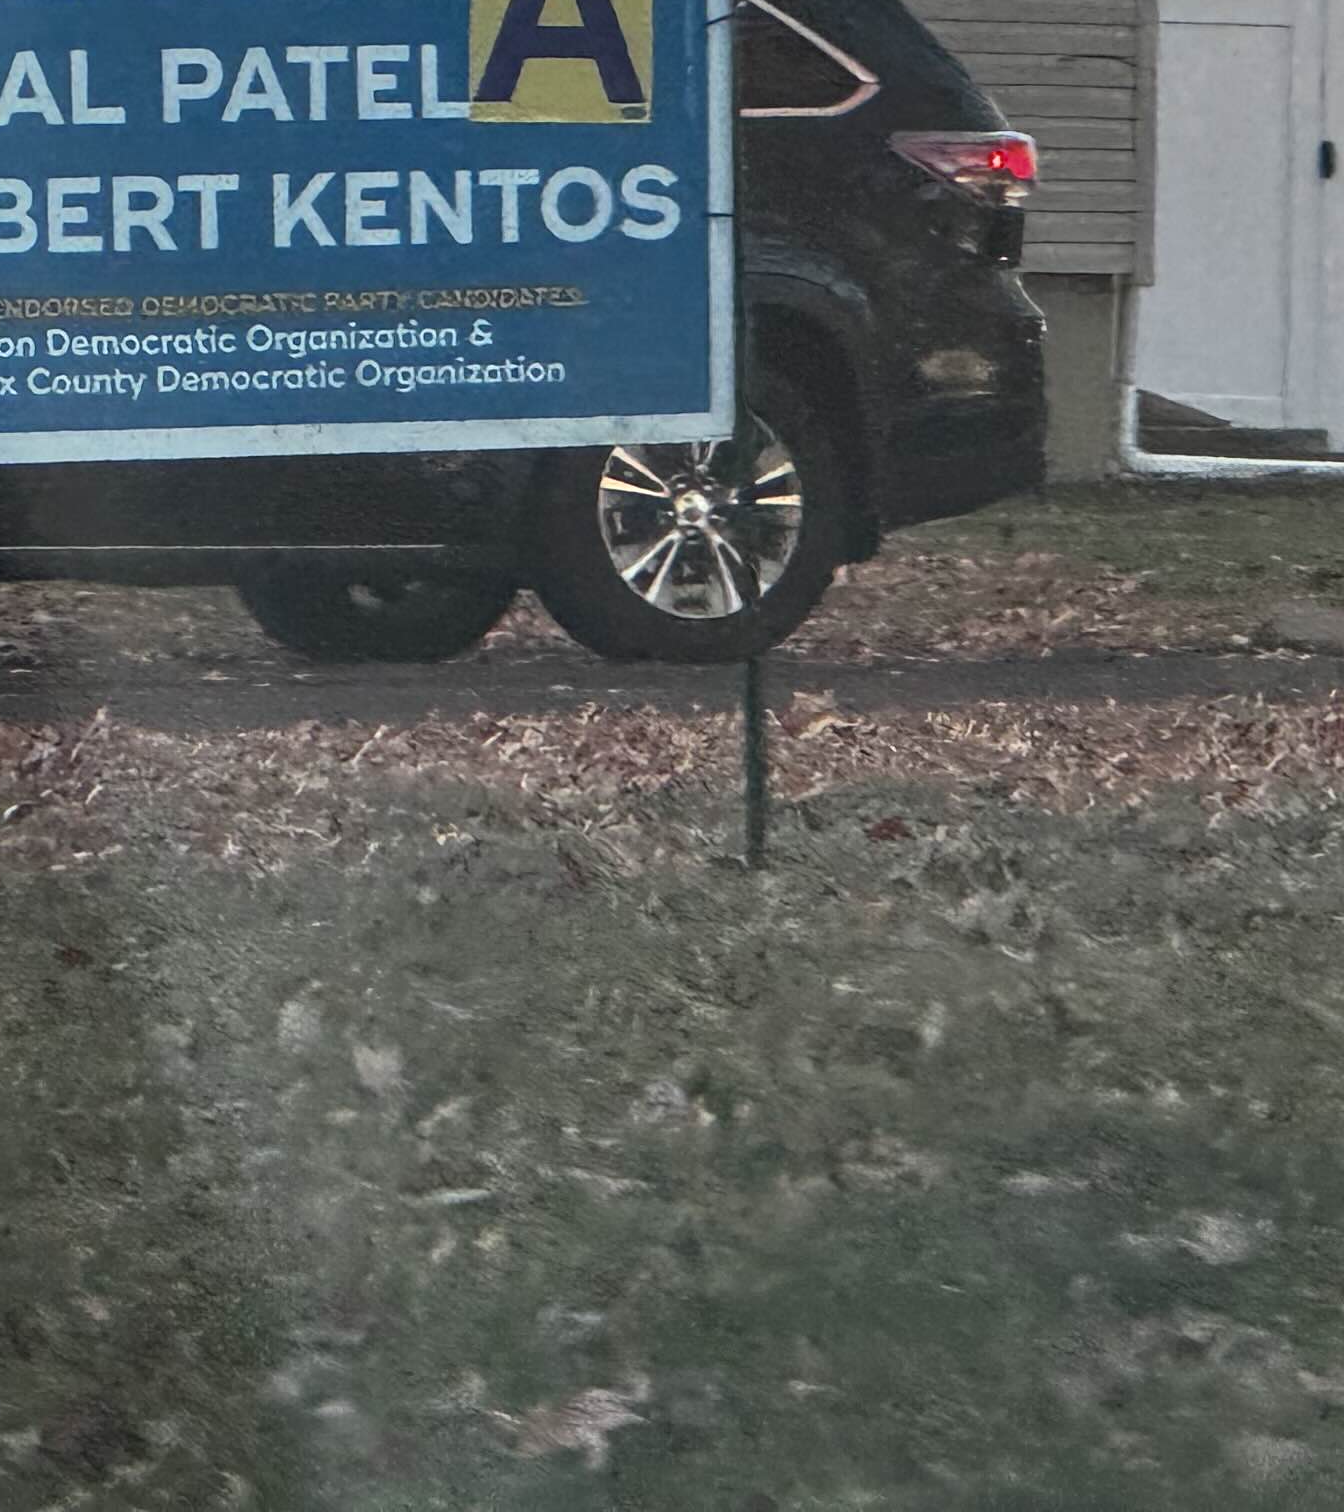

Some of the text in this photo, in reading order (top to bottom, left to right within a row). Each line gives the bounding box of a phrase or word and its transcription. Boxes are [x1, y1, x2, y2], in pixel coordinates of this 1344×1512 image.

[161, 43, 470, 123] PATEL
[272, 164, 681, 250] KENTOS
[142, 292, 317, 317] DEMOCRATIC
[324, 290, 410, 312] PARTY
[46, 325, 237, 358] Democratic
[246, 319, 458, 358] Organization
[469, 318, 493, 346] &
[26, 366, 149, 400] County
[157, 360, 346, 393] Democratic
[356, 355, 566, 392] Organization
